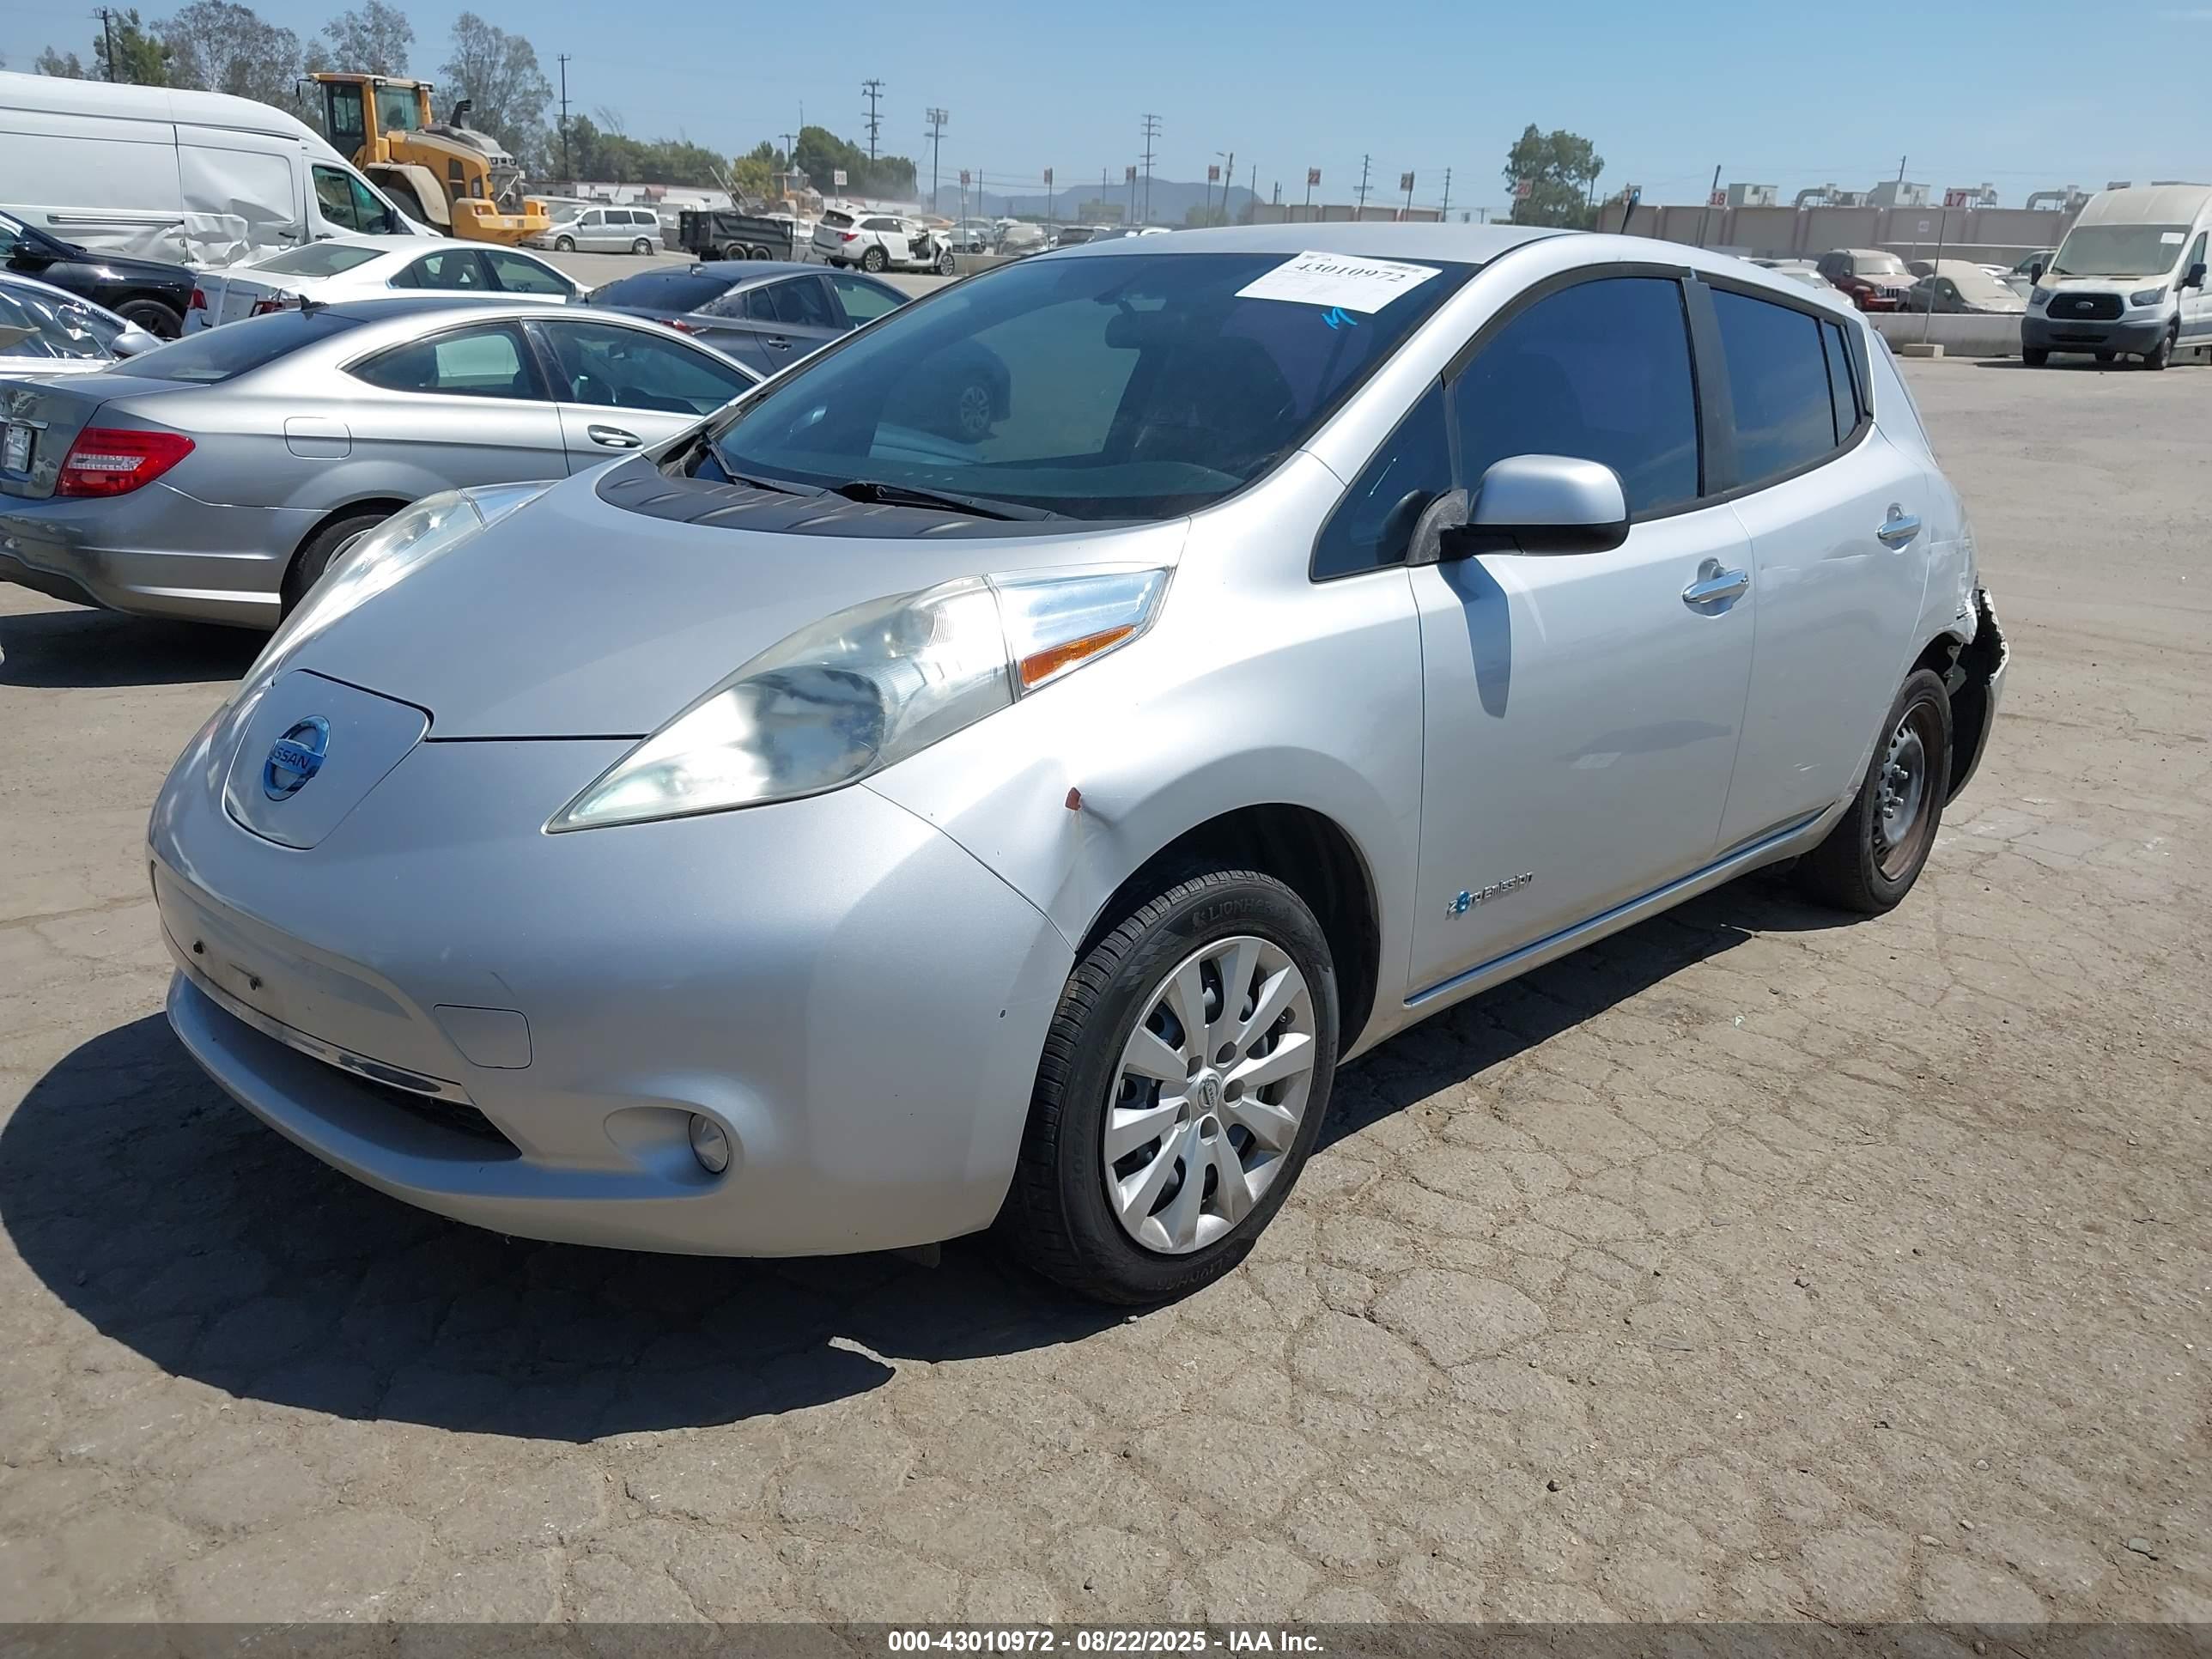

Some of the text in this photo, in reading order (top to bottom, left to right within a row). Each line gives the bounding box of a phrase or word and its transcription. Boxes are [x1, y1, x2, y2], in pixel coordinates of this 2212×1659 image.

[1517, 183, 1531, 195] 20
[1711, 191, 1726, 205] 18
[1944, 192, 1966, 206] 17
[1295, 262, 1407, 283] 43010972
